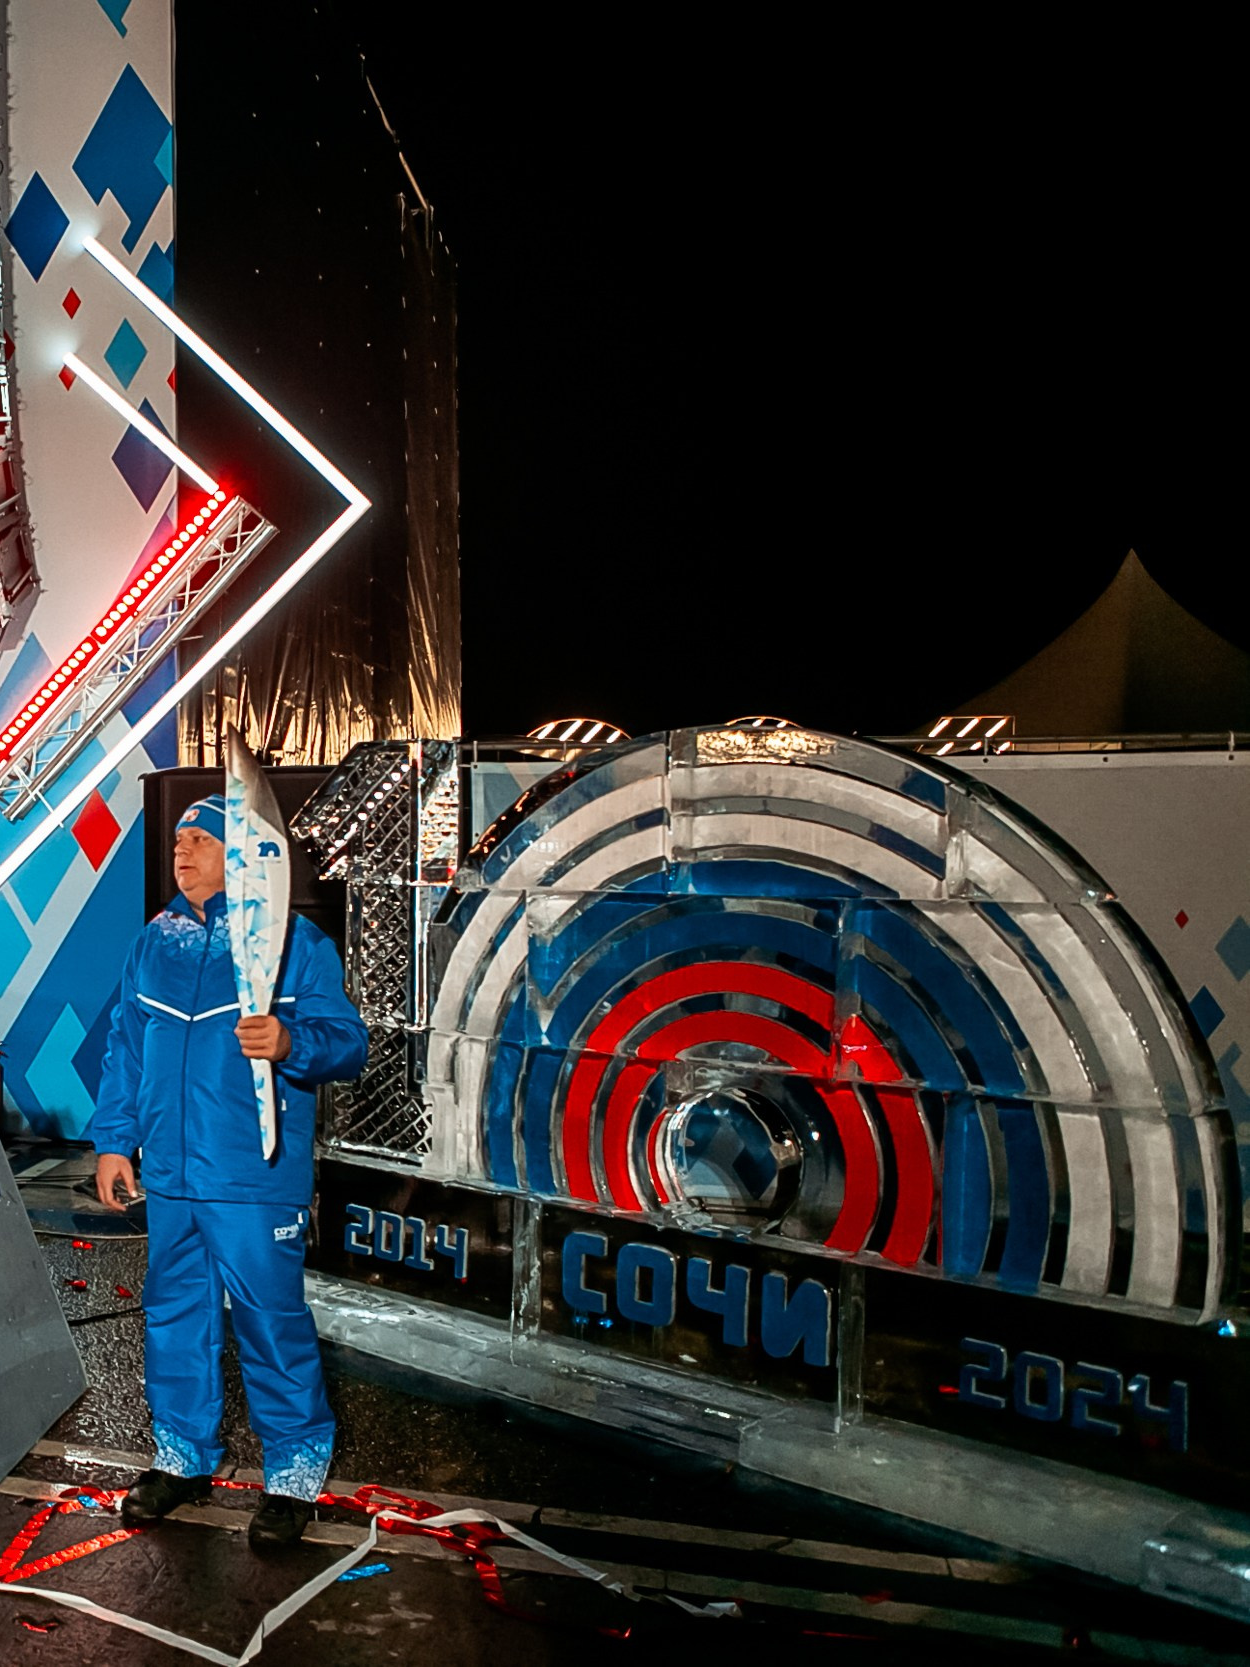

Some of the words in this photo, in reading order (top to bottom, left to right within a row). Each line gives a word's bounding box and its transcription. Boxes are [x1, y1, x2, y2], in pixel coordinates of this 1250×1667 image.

[344, 1203, 470, 1279] 2014
[562, 1230, 831, 1367] СОЧИ
[958, 1337, 1189, 1452] 2024
